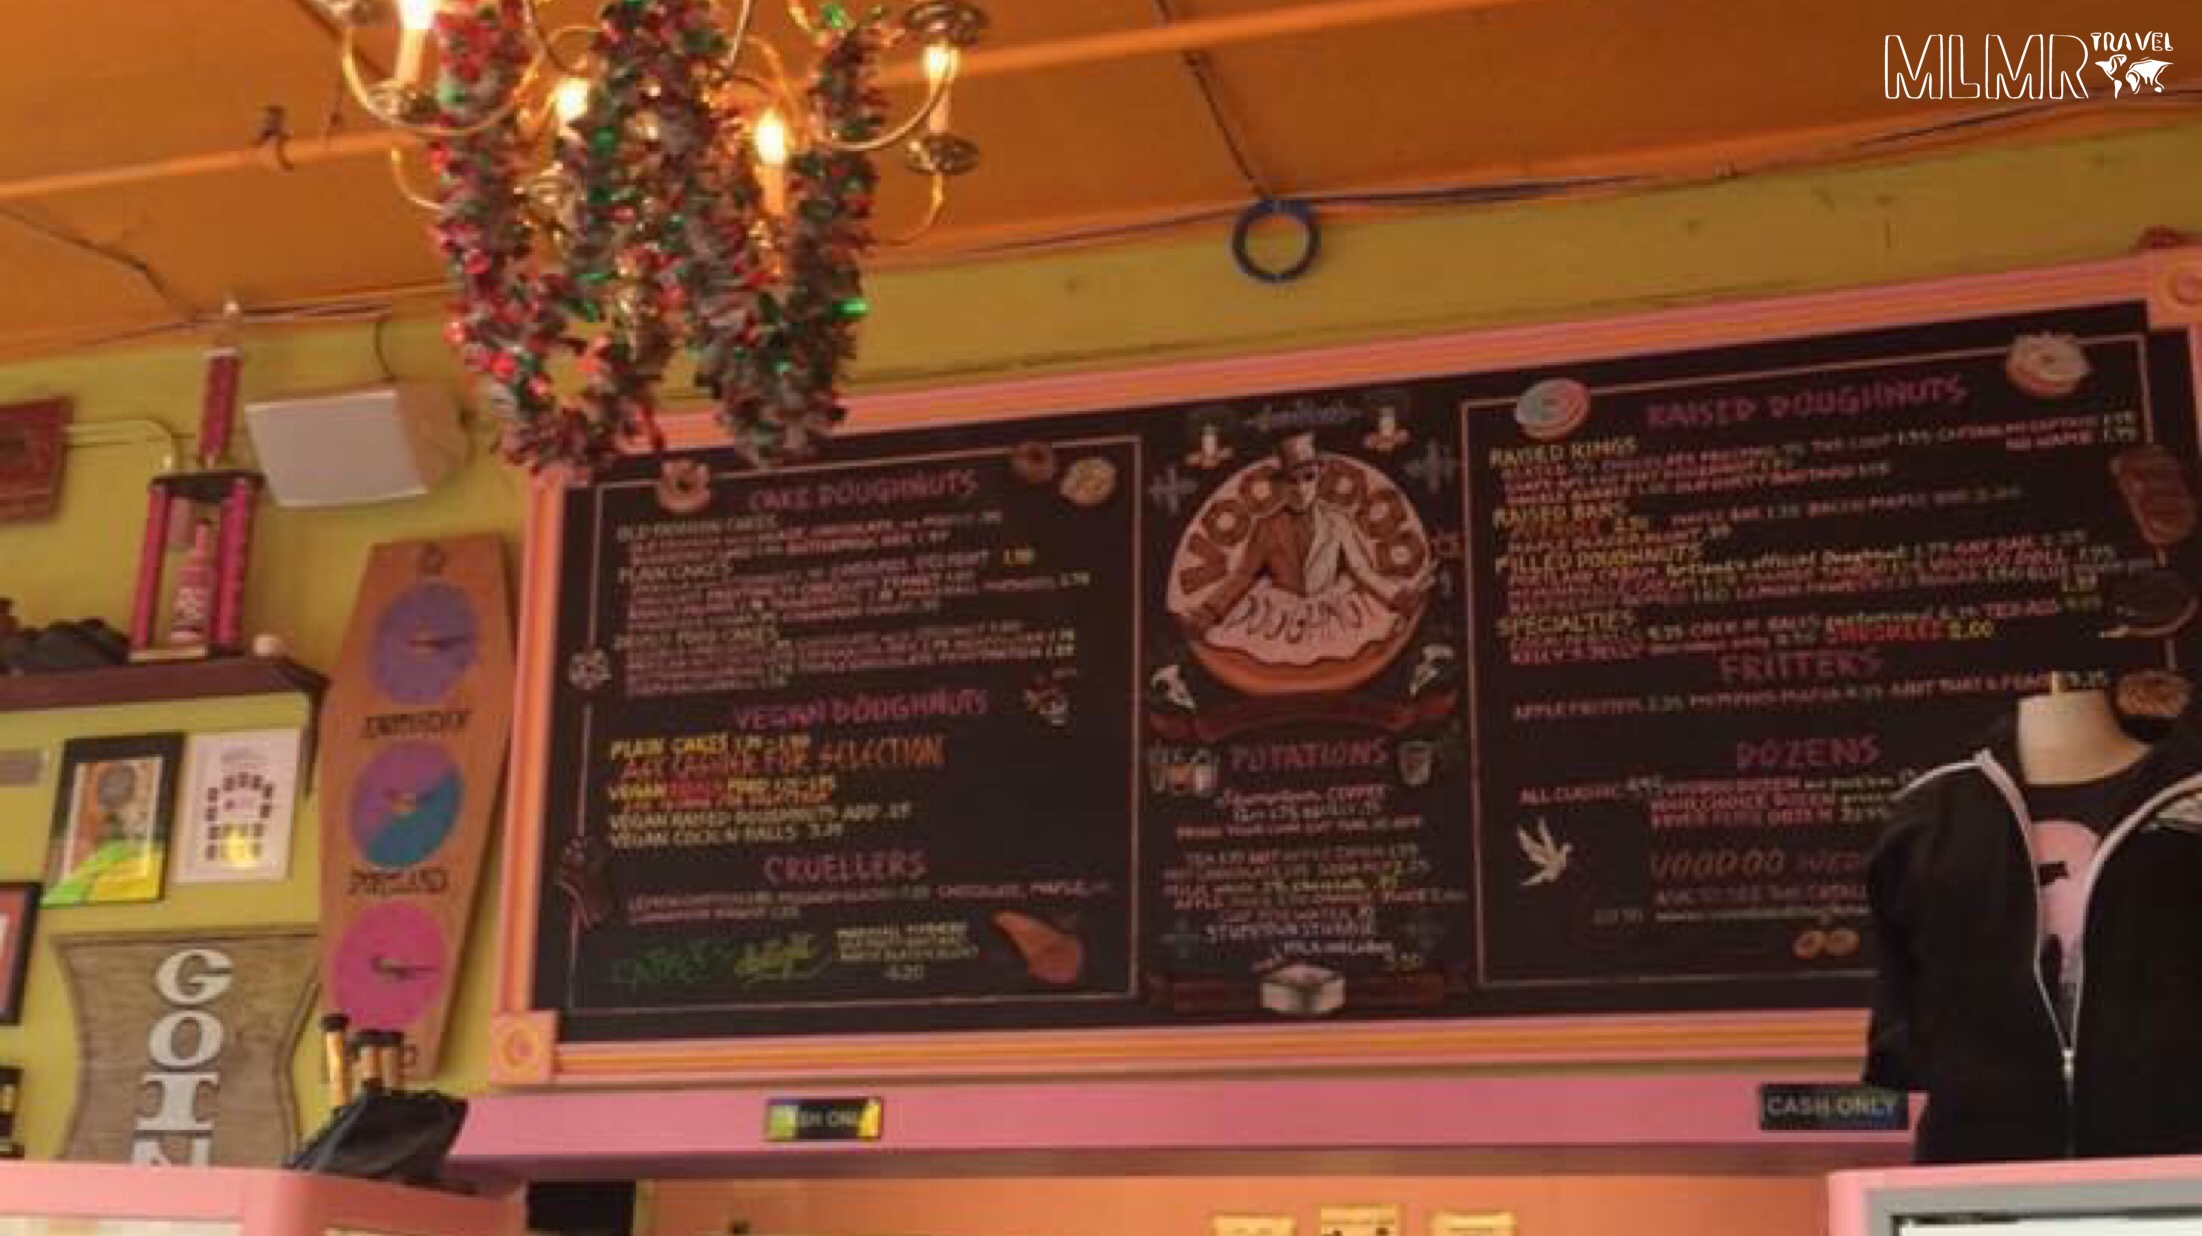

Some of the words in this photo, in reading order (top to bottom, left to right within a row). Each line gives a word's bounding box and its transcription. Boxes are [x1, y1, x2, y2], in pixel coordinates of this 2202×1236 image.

[1645, 397, 1757, 427] RAISED
[1767, 375, 1967, 419] DOUGHNUTS
[820, 471, 978, 504] DOUGHNUTS
[1718, 647, 1881, 682] FRITTERS
[834, 689, 988, 723] DOUGHNUTS
[820, 736, 946, 768] SELECTION
[1229, 738, 1390, 772] POTATIONS
[1736, 735, 1881, 769] DOZENS
[763, 849, 928, 884] CRUELLERS
[1649, 846, 1785, 879] VOODOO
[1766, 1095, 1831, 1118] CASH
[1837, 1093, 1895, 1116] ONLY
